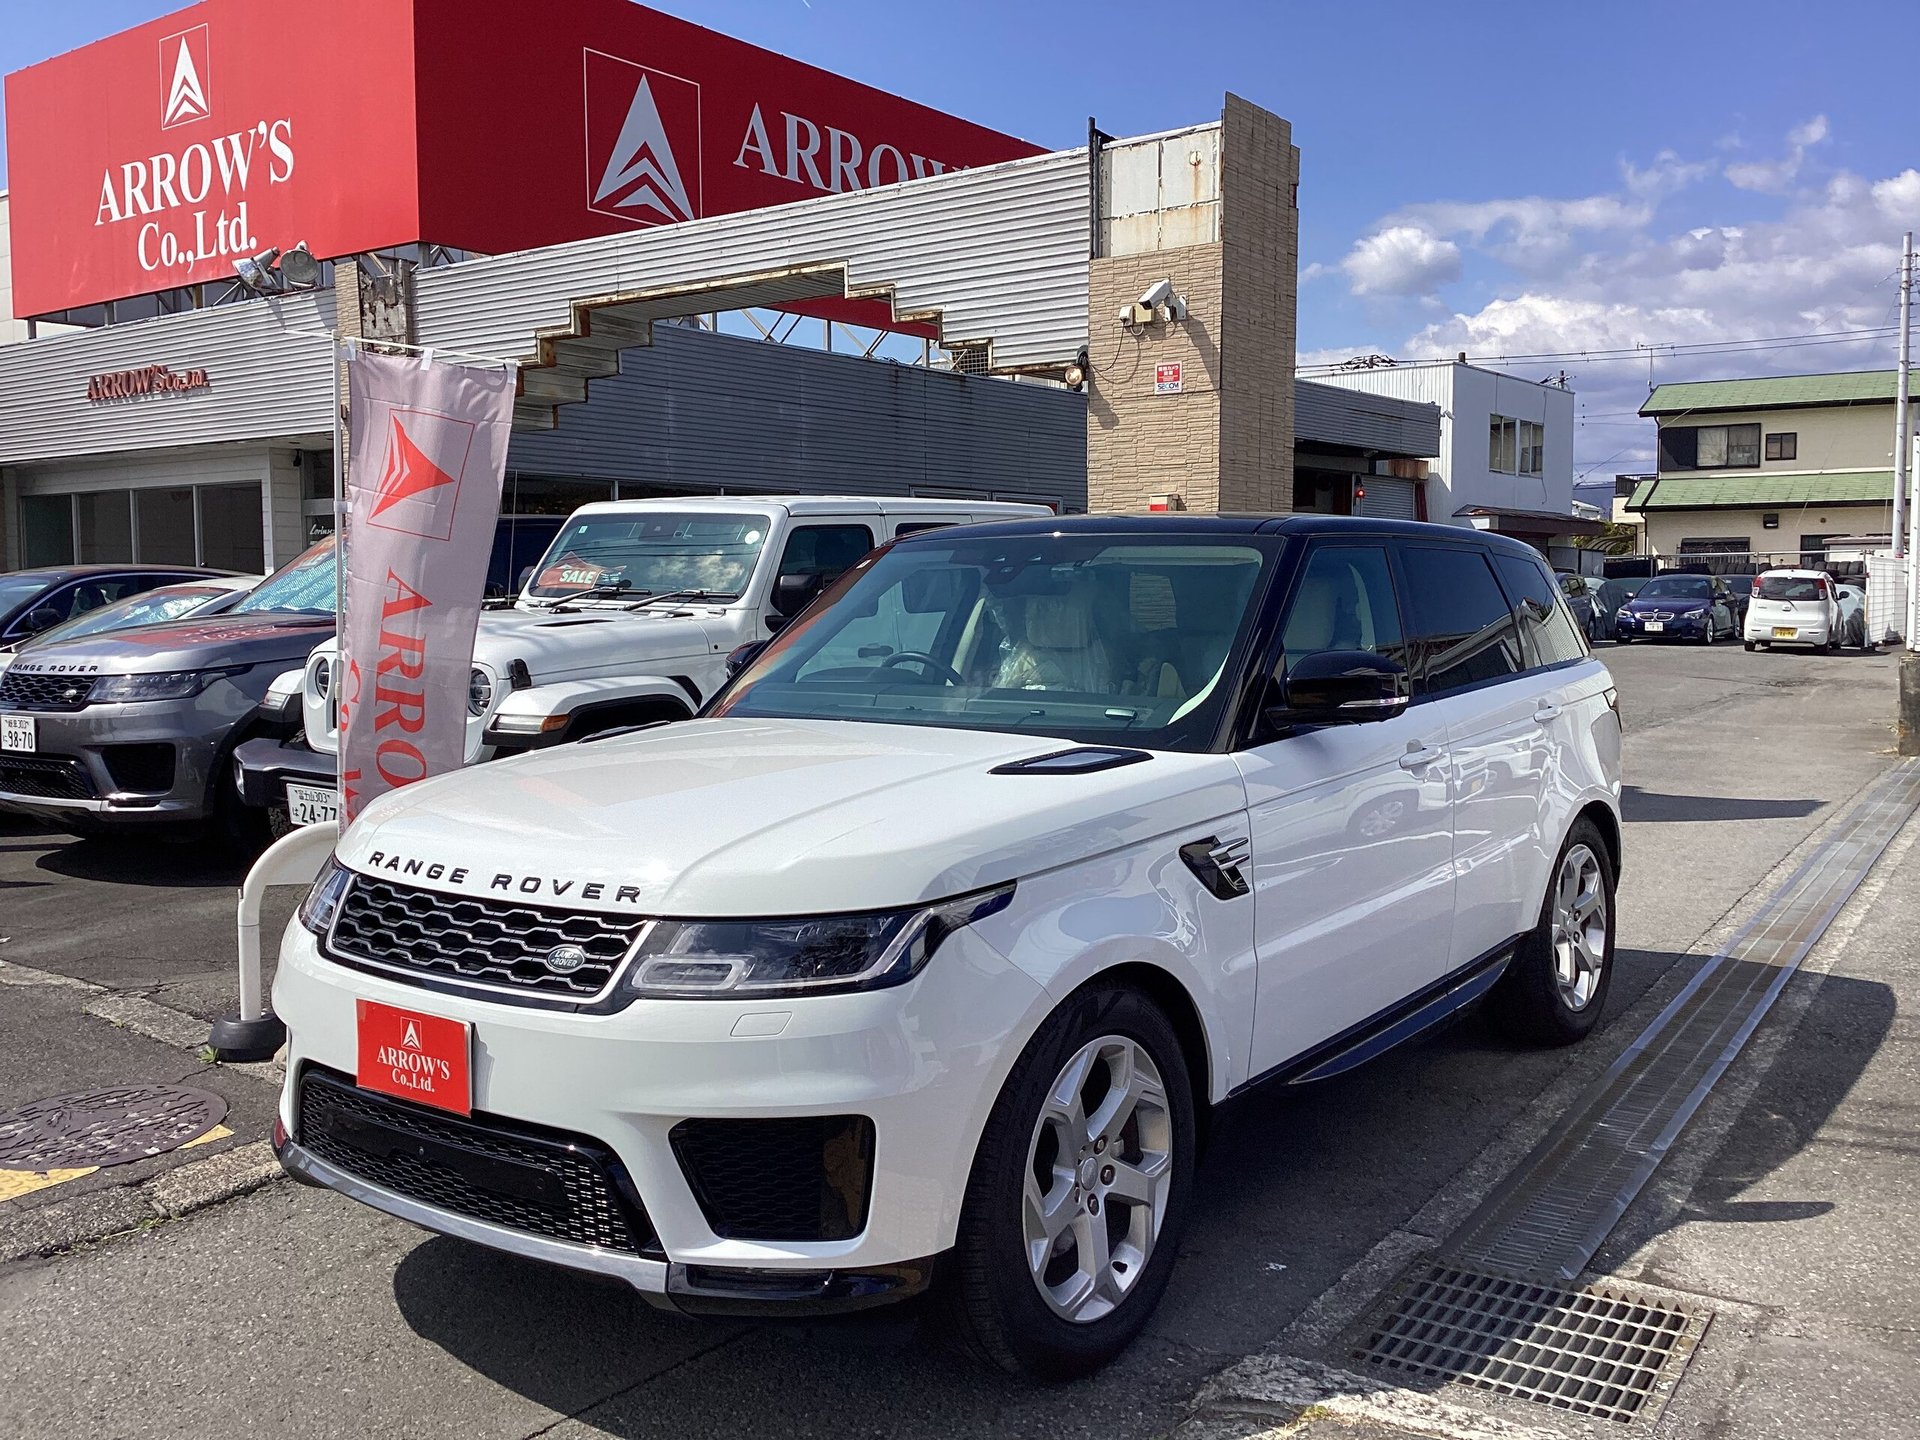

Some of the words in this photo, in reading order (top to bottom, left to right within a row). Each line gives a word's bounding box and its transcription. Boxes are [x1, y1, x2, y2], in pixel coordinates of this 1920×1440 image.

[94, 117, 295, 226] ARROW'S
[138, 201, 258, 274] Co.,Ltd.
[559, 570, 597, 584] SALE
[12, 663, 43, 672] RANGE
[300, 803, 337, 824] 24-77
[368, 851, 470, 884] RANGE
[490, 873, 642, 903] ROVER
[377, 1045, 450, 1080] ARROW'S
[391, 1068, 435, 1092] Co.,Ltd.
